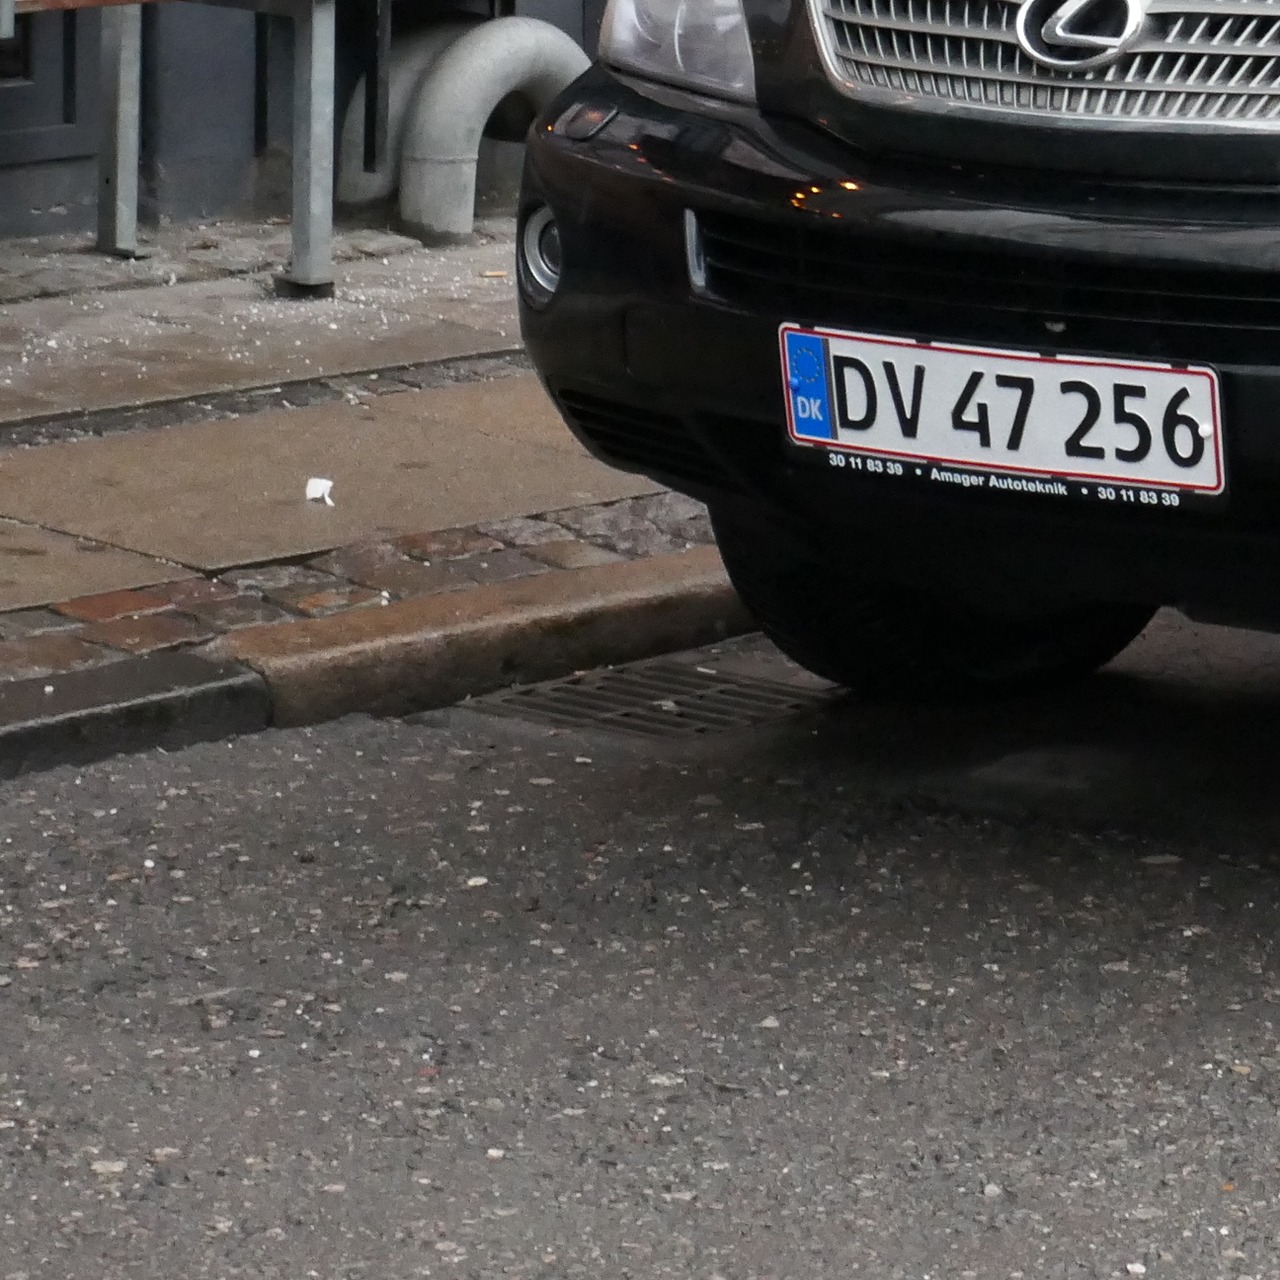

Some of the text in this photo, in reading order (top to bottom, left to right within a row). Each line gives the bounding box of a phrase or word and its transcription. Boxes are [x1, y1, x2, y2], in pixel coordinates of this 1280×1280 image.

[797, 395, 824, 422] DK
[832, 355, 1205, 469] DV 47 256
[829, 453, 1180, 507] 30 11 83 39 Amager Autoteknik 30 11 83 39
